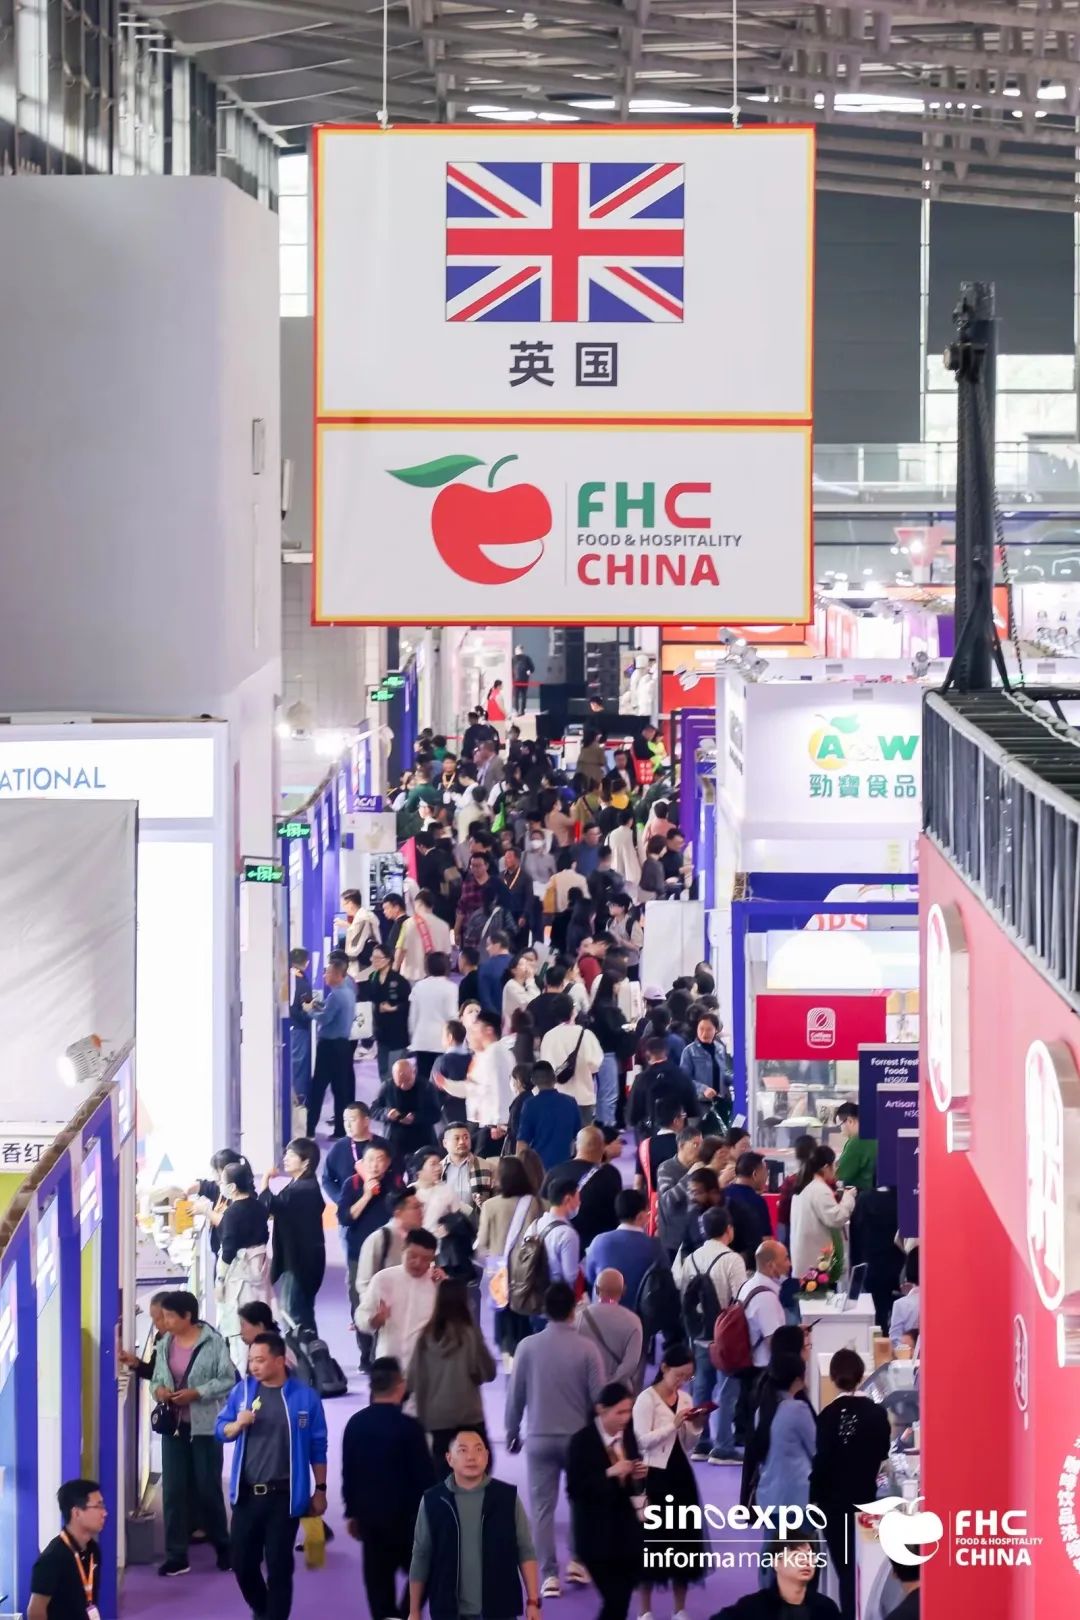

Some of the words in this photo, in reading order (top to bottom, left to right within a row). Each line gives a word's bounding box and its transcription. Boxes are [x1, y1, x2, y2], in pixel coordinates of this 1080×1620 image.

[509, 341, 618, 388] 英国
[578, 482, 712, 529] FHC
[577, 533, 621, 546] FOOD
[625, 534, 636, 546] &
[640, 534, 742, 547] HOSPITALITY
[577, 553, 720, 586] CHINA
[2, 1143, 54, 1163] 香红
